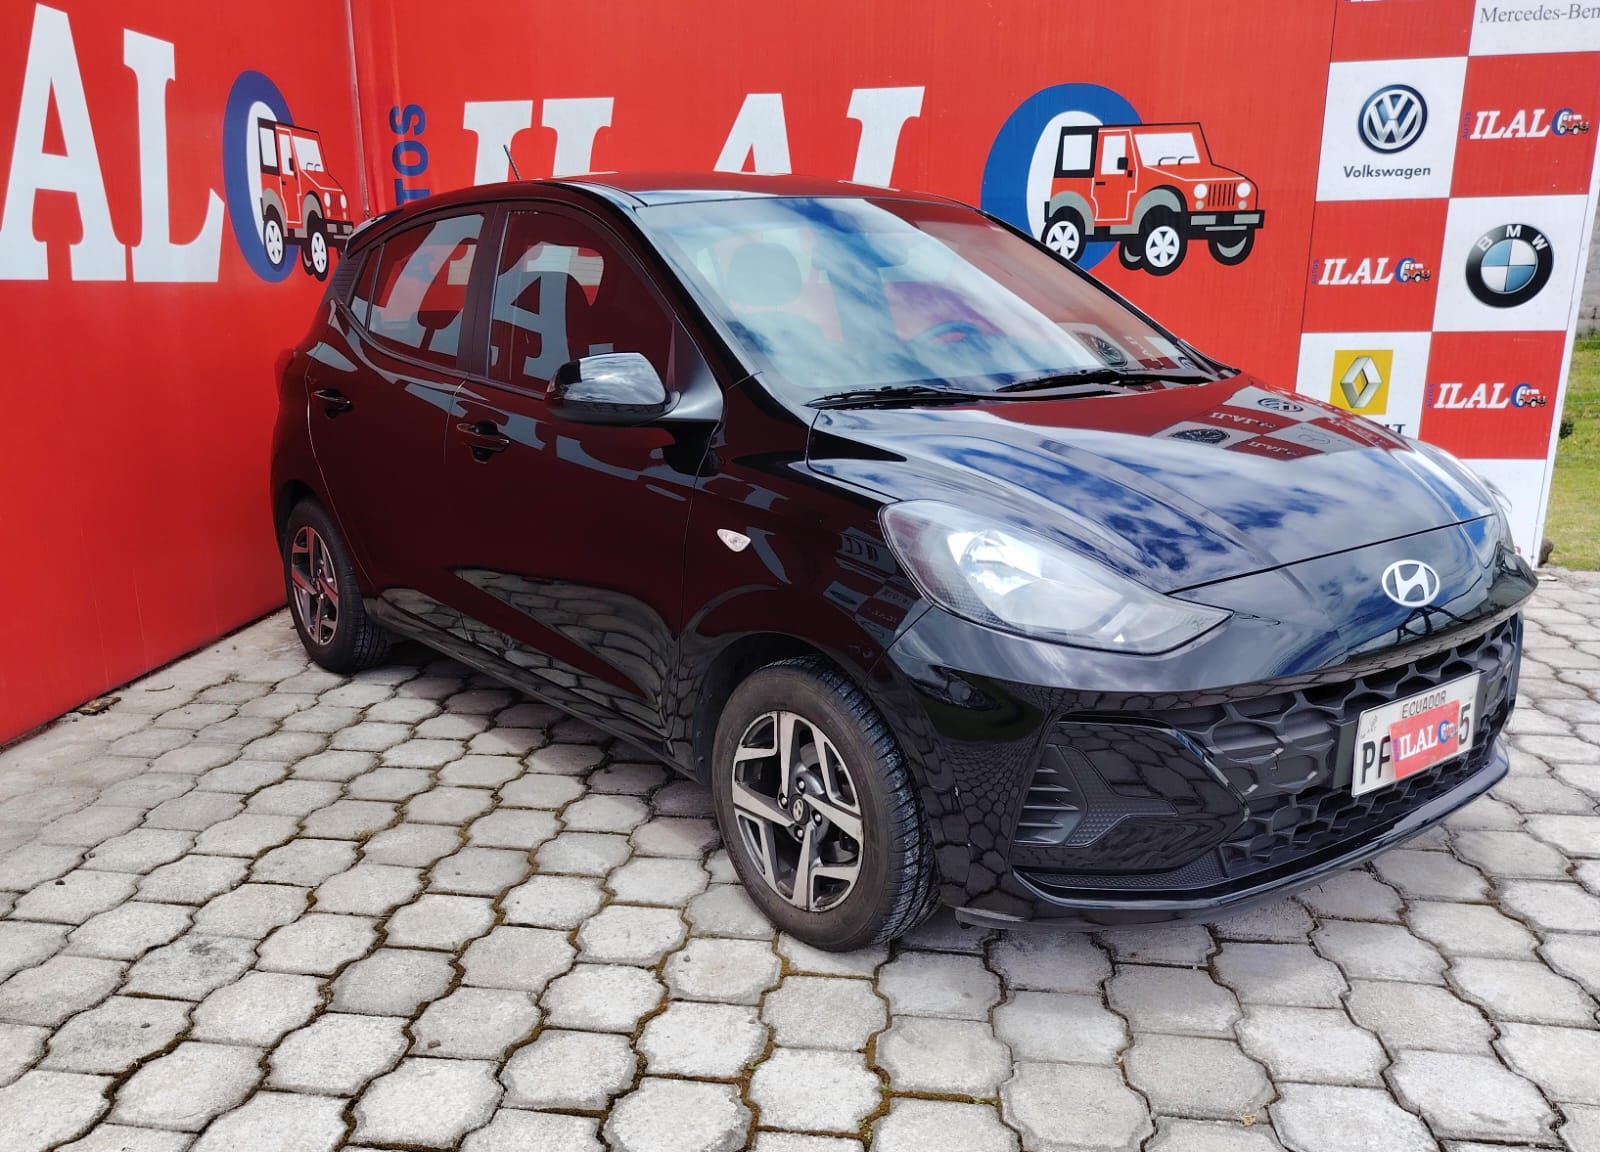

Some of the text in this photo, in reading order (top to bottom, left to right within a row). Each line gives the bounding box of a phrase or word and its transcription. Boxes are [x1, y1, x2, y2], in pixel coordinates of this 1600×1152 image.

[1343, 164, 1431, 180] Volkswagen
[1476, 224, 1548, 252] BMW
[1401, 690, 1447, 719] ECUADOR
